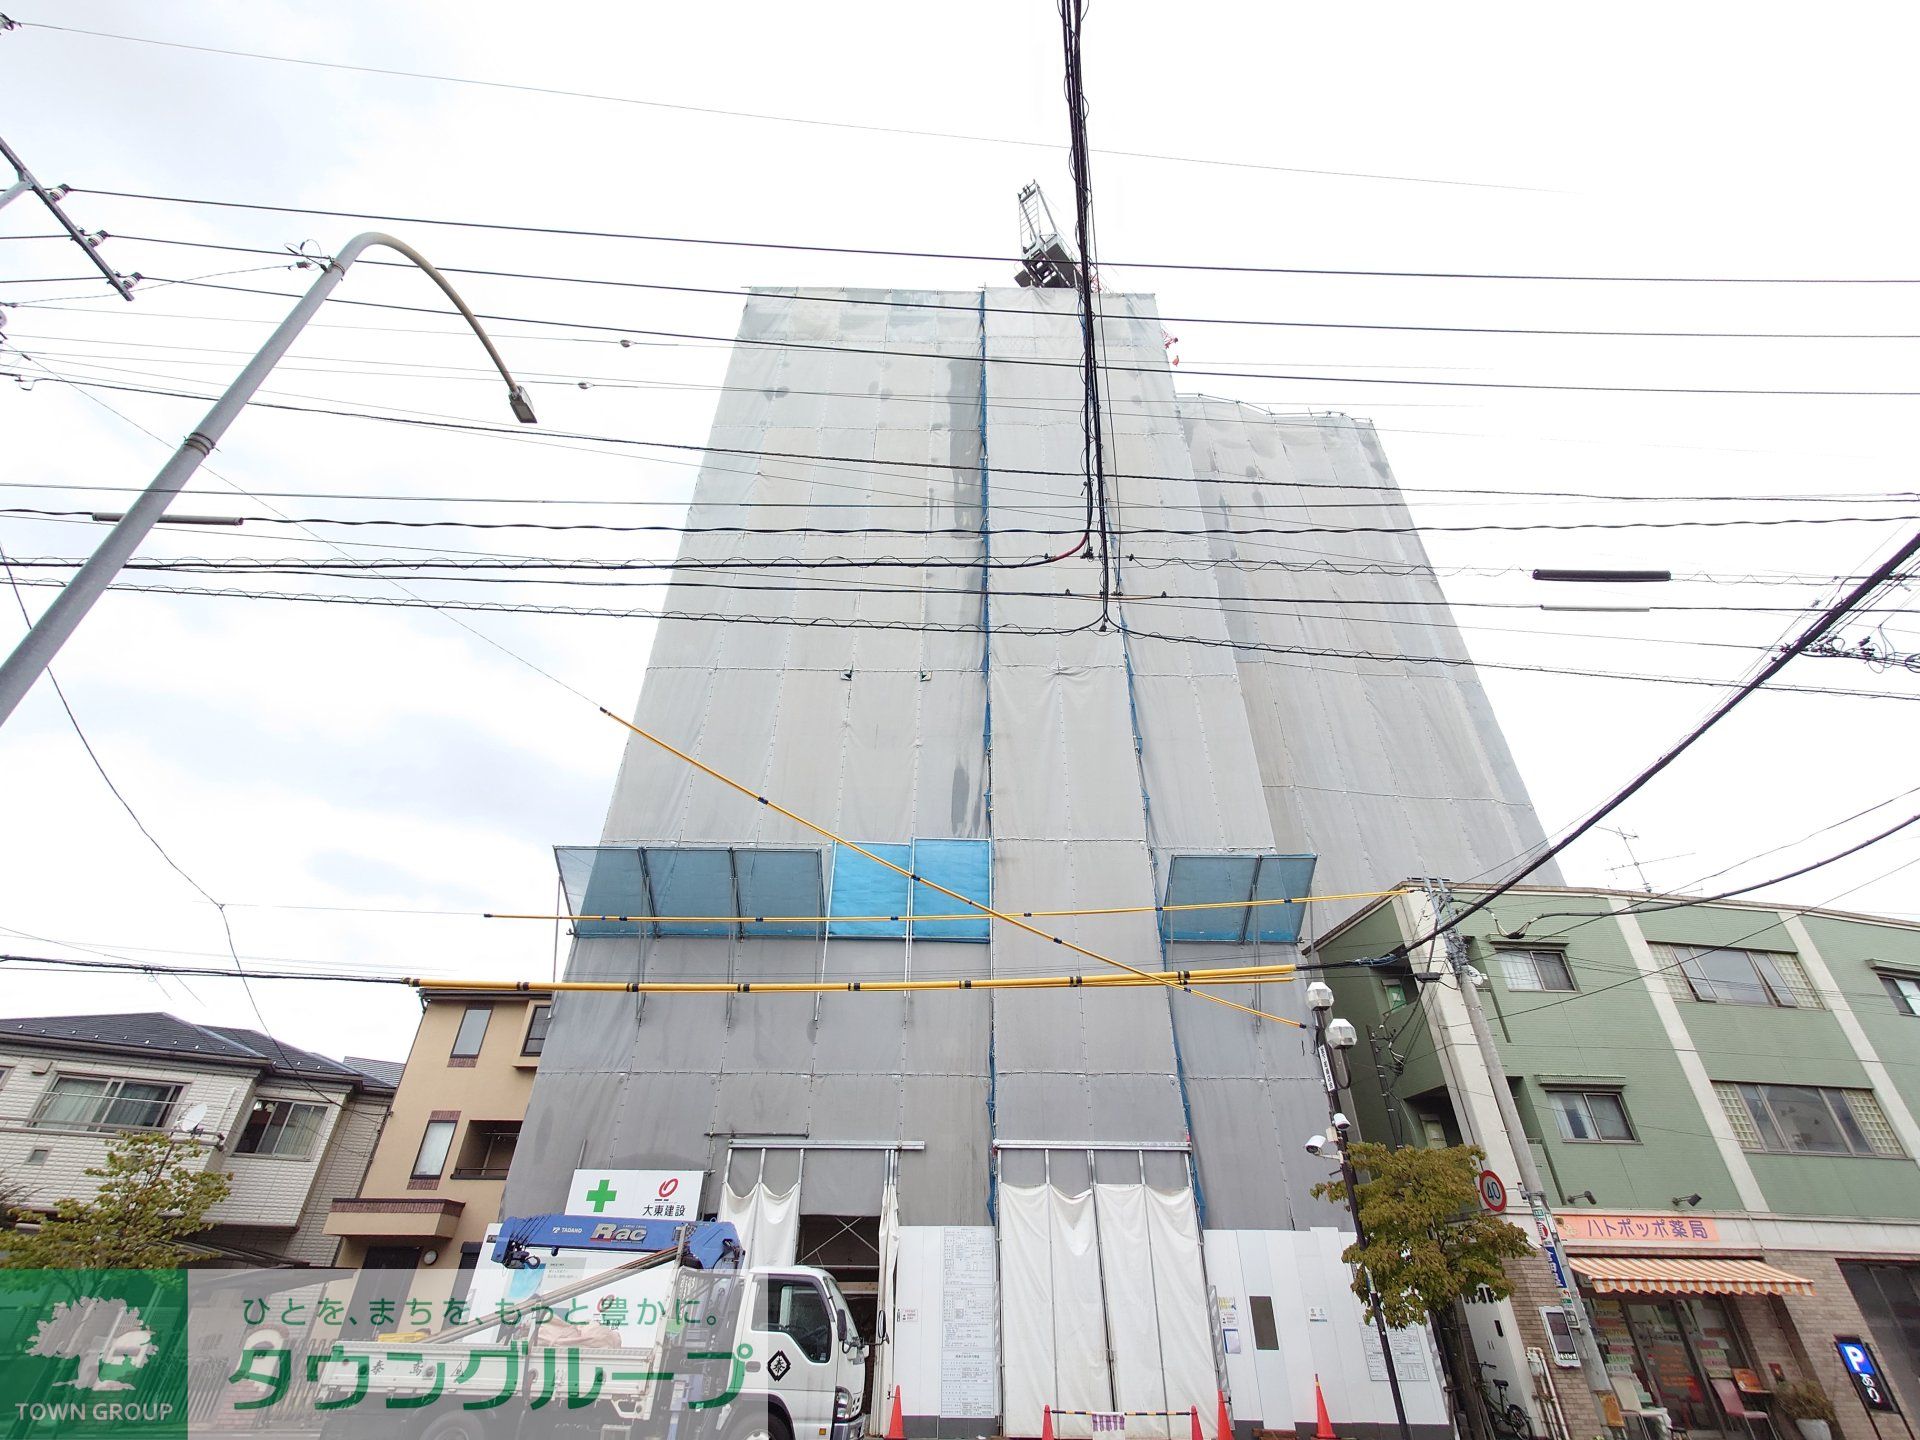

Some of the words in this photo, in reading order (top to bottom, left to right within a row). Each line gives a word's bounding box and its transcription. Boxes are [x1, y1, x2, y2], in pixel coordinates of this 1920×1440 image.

[1487, 1182, 1501, 1200] 40
[643, 1204, 686, 1217] 大東建設
[590, 1223, 648, 1242] Rac
[1588, 1217, 1708, 1239] ハトポッポ薬局
